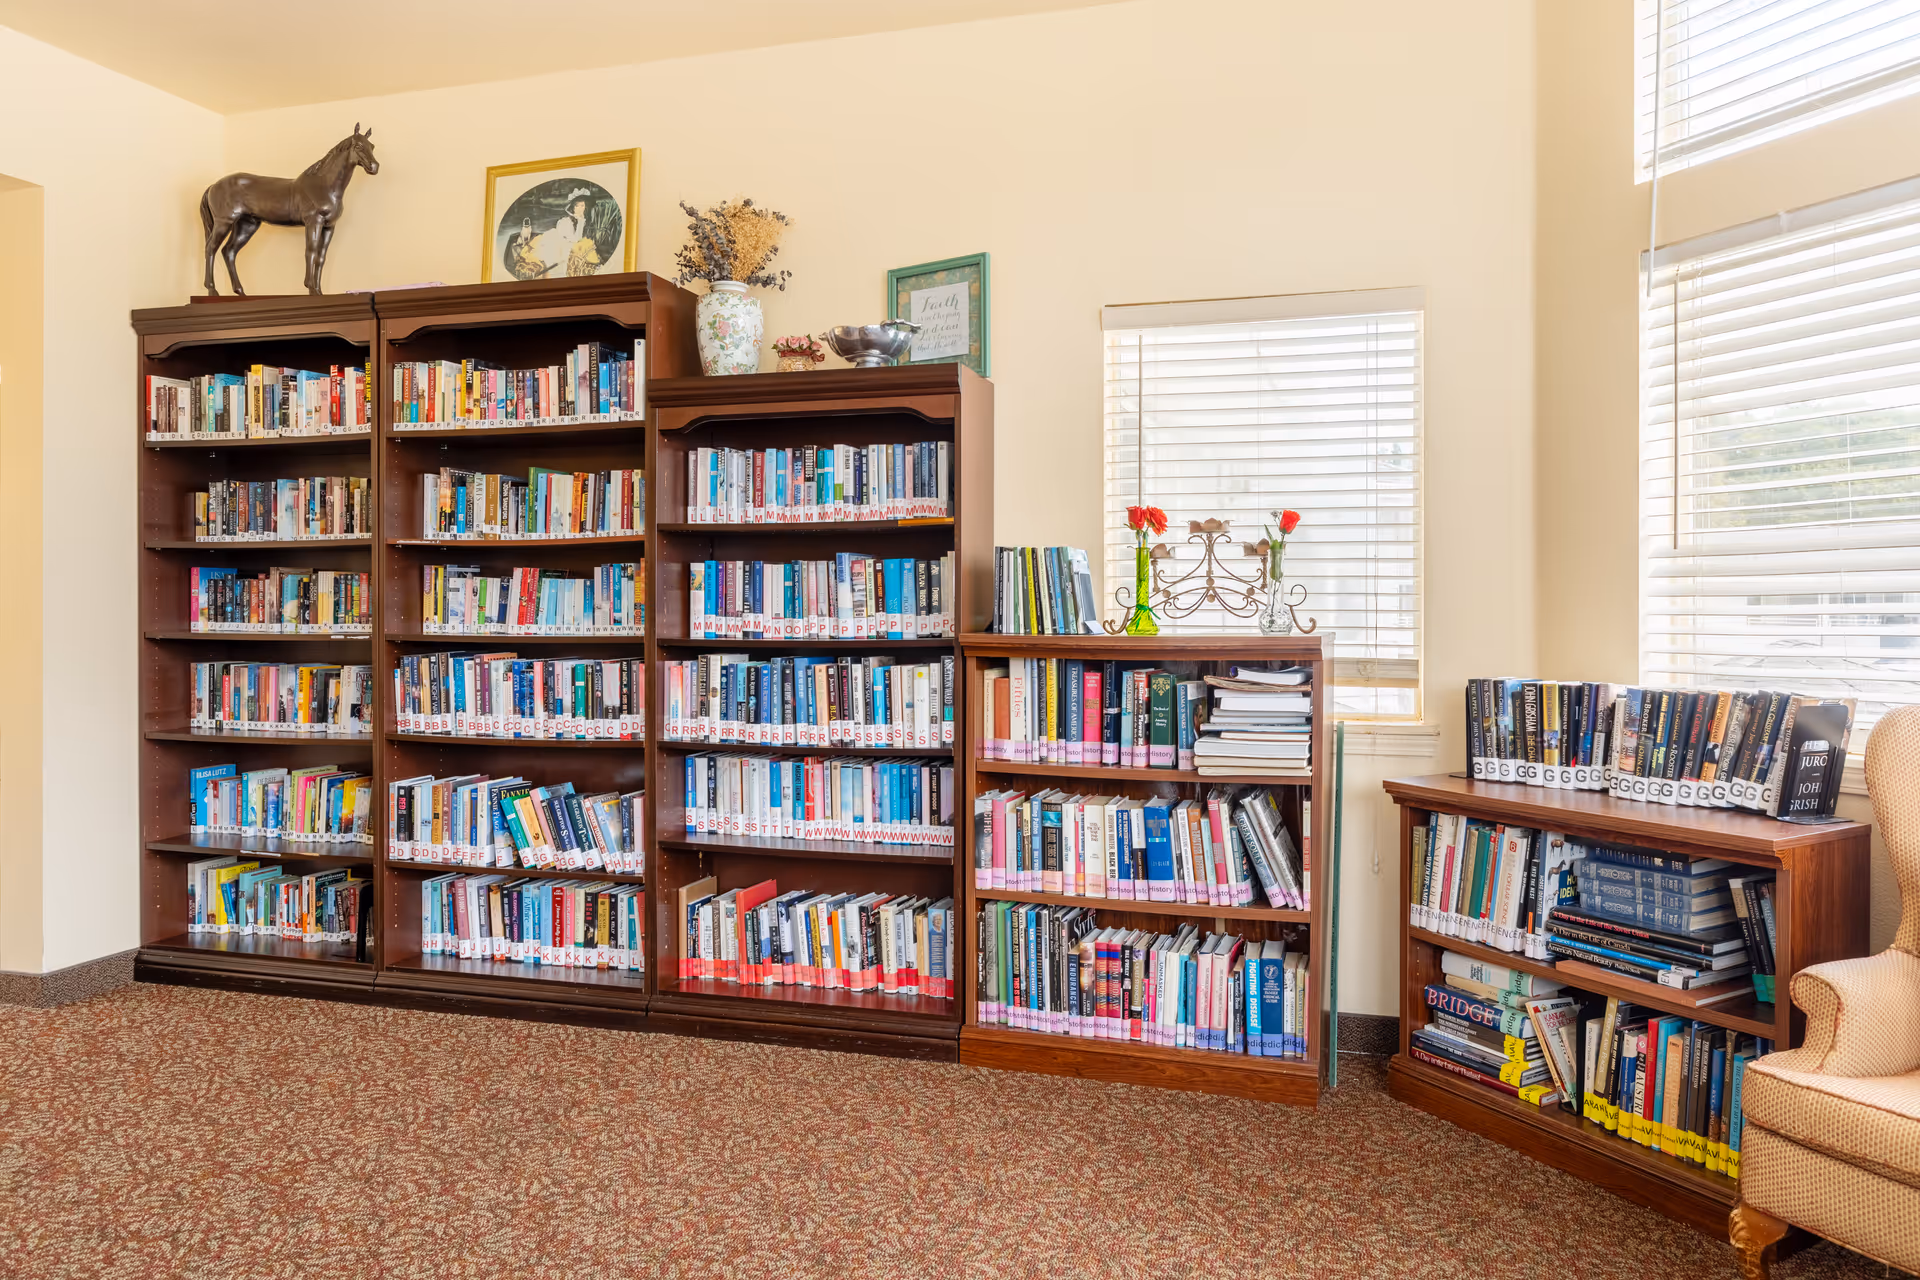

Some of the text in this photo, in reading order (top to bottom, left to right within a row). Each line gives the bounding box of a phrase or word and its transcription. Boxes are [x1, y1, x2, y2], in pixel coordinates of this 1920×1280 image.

[921, 294, 960, 314] Faith
[805, 513, 813, 521] M
[870, 510, 878, 518] M
[727, 624, 735, 632] M
[794, 626, 801, 634] O
[857, 625, 863, 633] P
[906, 622, 912, 630] P
[1014, 676, 1023, 717] Fifties
[1524, 686, 1536, 703] JOHN
[1071, 703, 1078, 712] OF
[1525, 704, 1536, 732] GRISHAM
[1642, 704, 1652, 732] BROKER
[1763, 695, 1780, 743] JOHN GRISHAM
[576, 724, 582, 732] C
[621, 722, 628, 731] D
[710, 727, 716, 735] R
[1691, 712, 1702, 743] GRISHAM
[785, 732, 792, 740] R
[866, 733, 872, 741] S
[945, 730, 952, 739] S
[1666, 750, 1677, 778] ROOSTER
[1800, 756, 1828, 770] JURO
[212, 768, 226, 776] LUTZ
[1500, 764, 1510, 776] G
[1561, 770, 1572, 783] G
[1632, 781, 1644, 794] G
[1679, 785, 1692, 798] G
[1730, 783, 1744, 797] G
[501, 788, 530, 801] FANNIE
[555, 808, 565, 830] GRAFTON
[573, 808, 582, 829] GRAFTON
[772, 825, 778, 833] T
[911, 833, 921, 842] W
[1240, 818, 1263, 865] GREAT SOULS
[432, 851, 438, 859] D
[522, 856, 530, 864] G
[624, 860, 631, 868] H
[1502, 873, 1513, 926] POPULAR SCIENCE
[1764, 905, 1776, 937] MENTOR
[1558, 928, 1571, 938] Day
[1578, 932, 1588, 941] the
[1588, 934, 1600, 944] Life
[1600, 938, 1607, 946] of
[1608, 940, 1631, 951] Canada
[932, 935, 943, 962] BARBARA
[1548, 944, 1572, 956] America's
[1573, 948, 1593, 961] Natural
[1593, 955, 1613, 968] Beauty
[1069, 963, 1078, 1005] ENDURANCE
[1112, 962, 1120, 1011] TOM BROKAW
[1100, 979, 1108, 1010] BROKAW
[1249, 962, 1258, 1027] FIGHTING DISEASE
[1427, 988, 1495, 1026] BRIDGE
[1544, 1011, 1567, 1022] KANTAR
[1547, 1018, 1566, 1029] FOR THE
